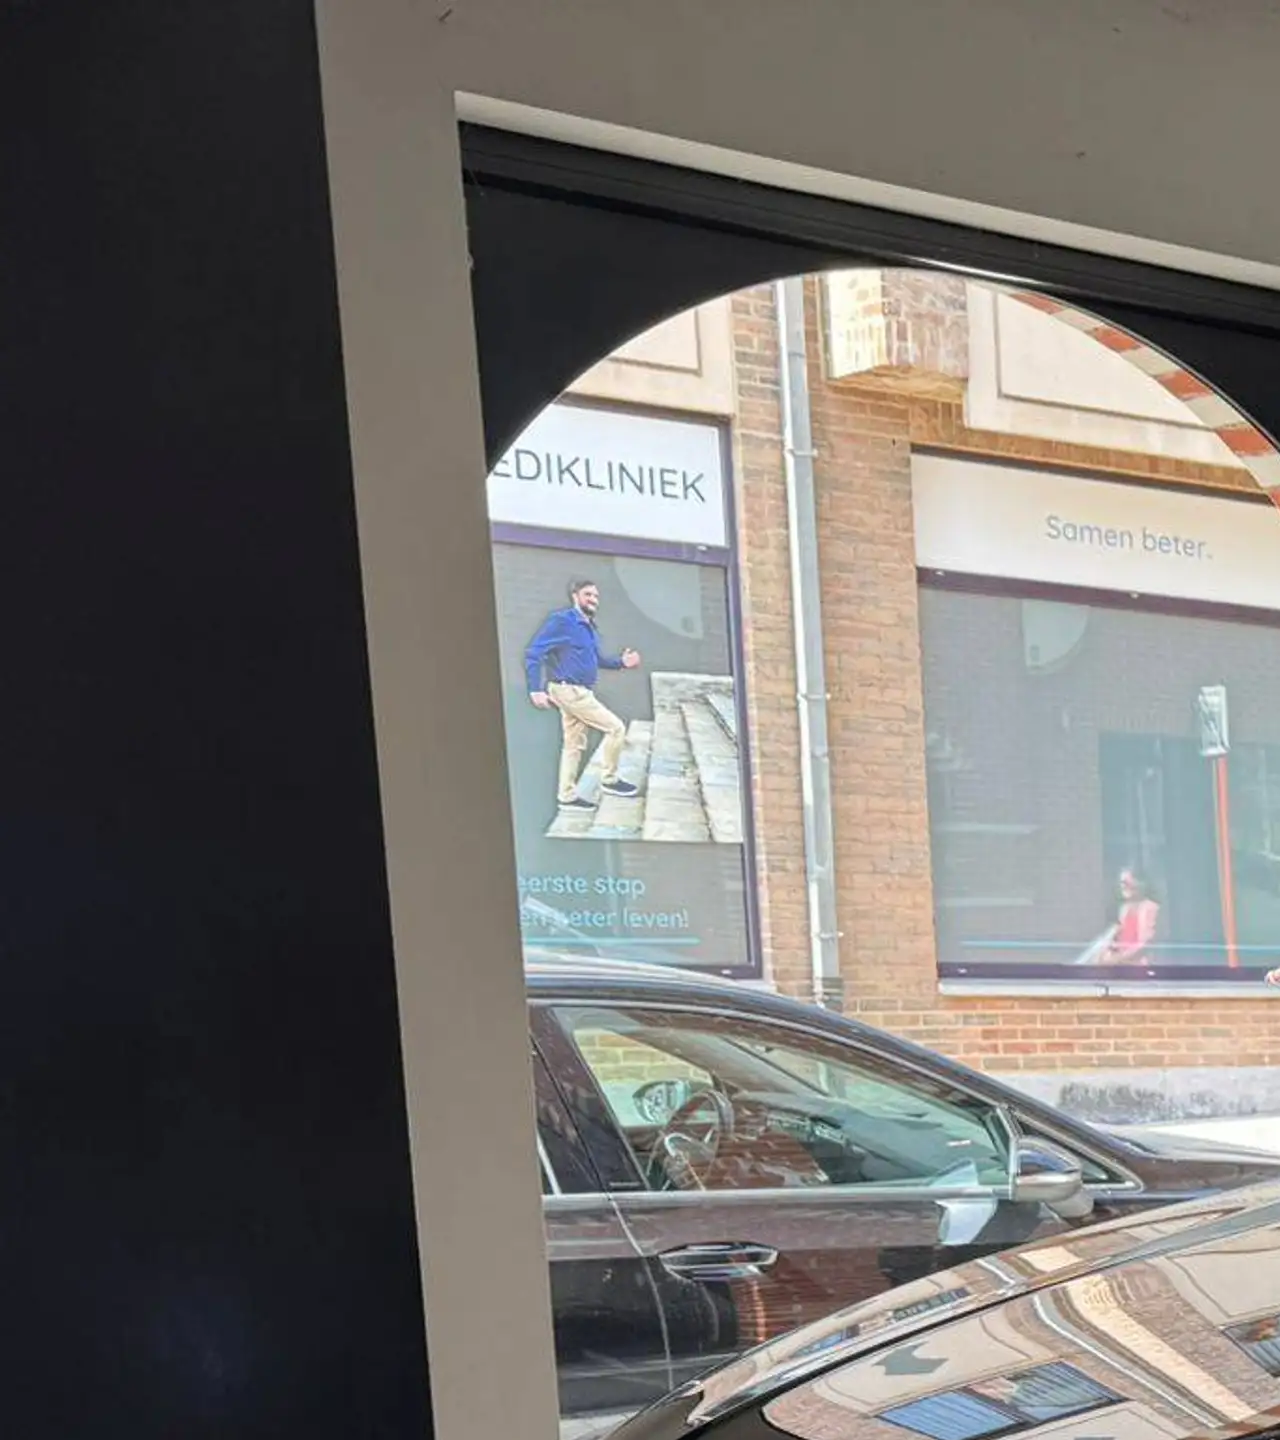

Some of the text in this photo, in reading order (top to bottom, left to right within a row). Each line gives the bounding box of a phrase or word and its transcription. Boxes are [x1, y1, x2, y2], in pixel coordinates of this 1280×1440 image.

[1045, 513, 1213, 560] Samen beter.
[593, 874, 646, 899] stap
[557, 907, 617, 927] eter
[623, 906, 689, 928] leven!
